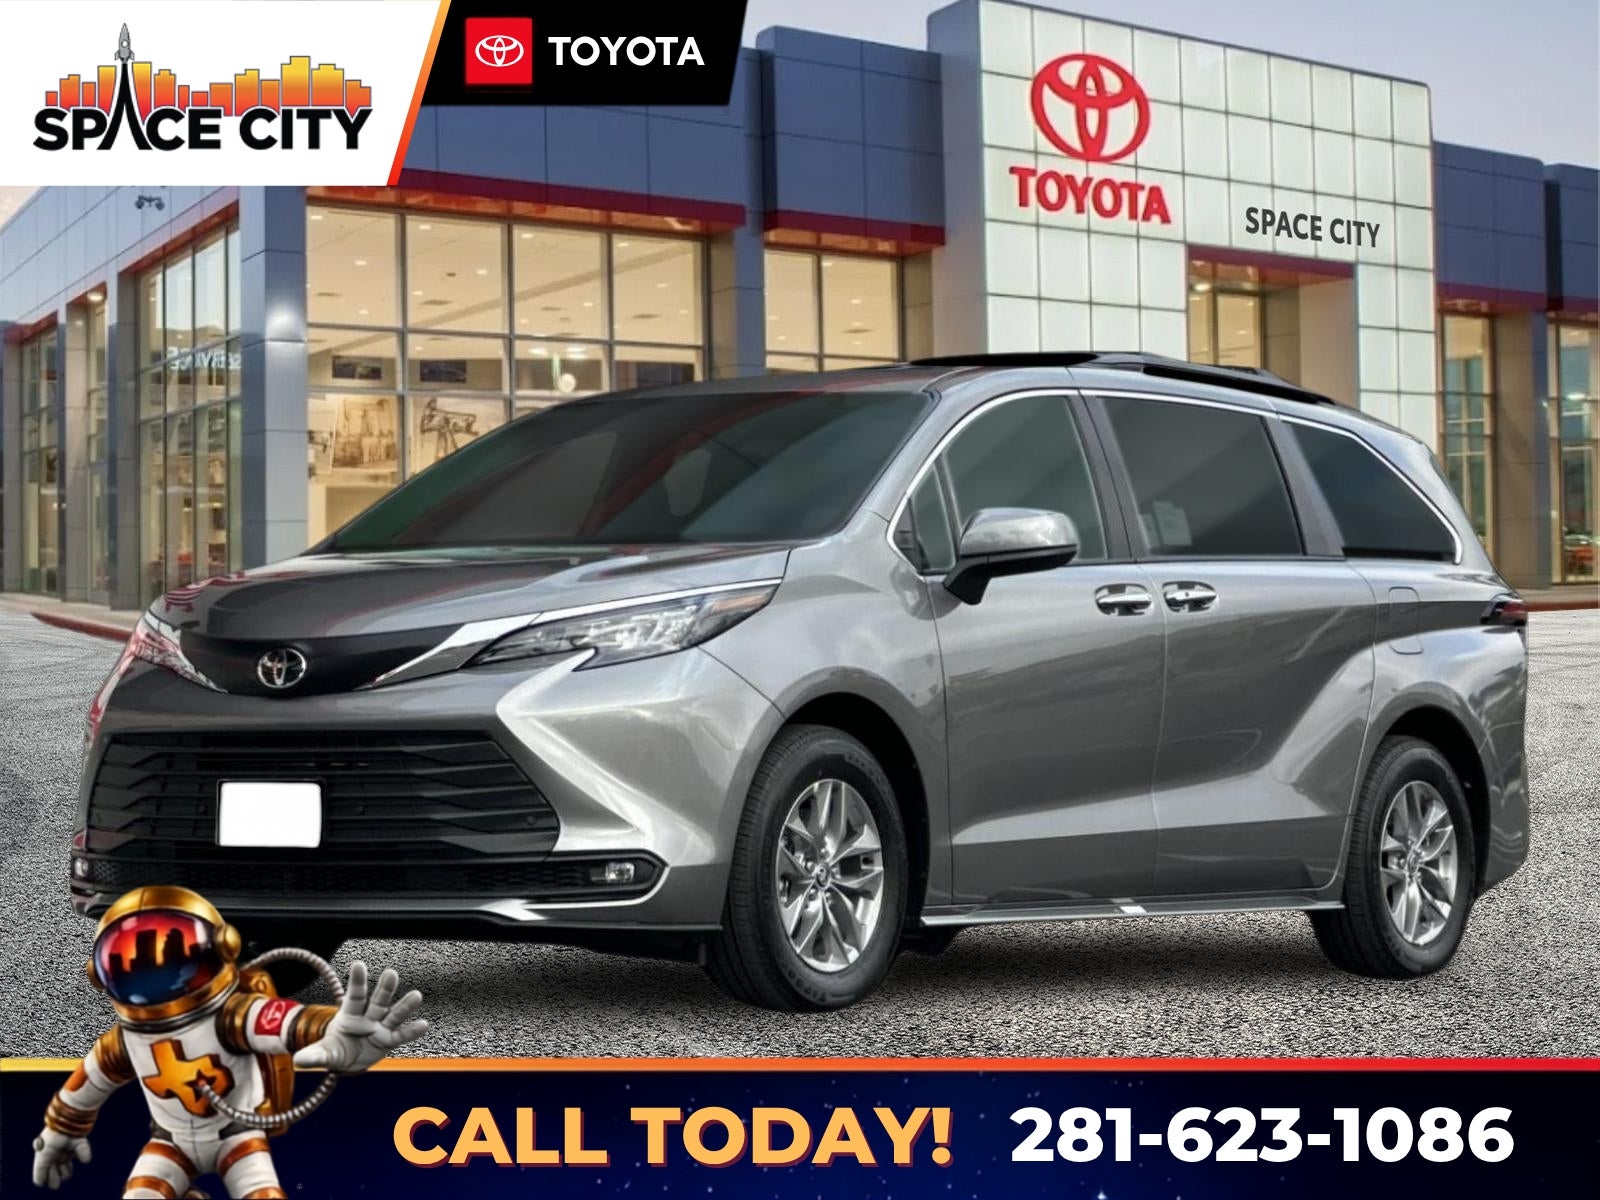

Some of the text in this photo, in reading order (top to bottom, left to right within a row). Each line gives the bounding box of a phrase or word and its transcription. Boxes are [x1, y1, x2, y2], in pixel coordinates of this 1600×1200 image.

[1009, 166, 1171, 225] TOYOTA
[1244, 206, 1381, 248] SPACE CITY
